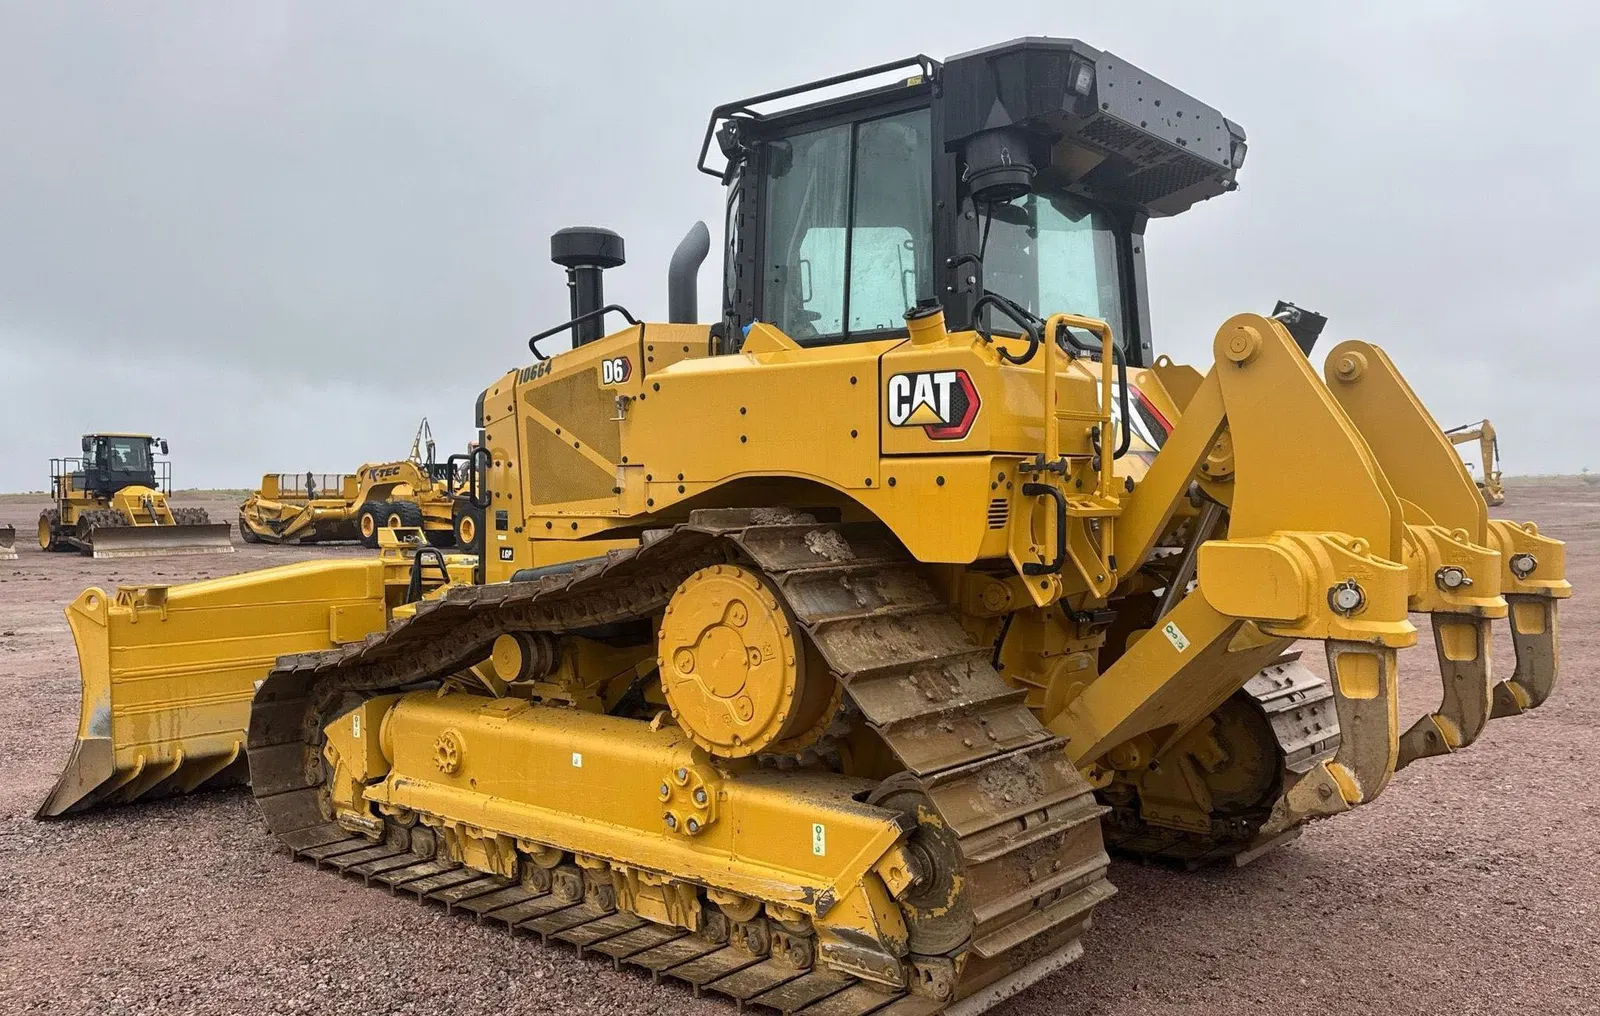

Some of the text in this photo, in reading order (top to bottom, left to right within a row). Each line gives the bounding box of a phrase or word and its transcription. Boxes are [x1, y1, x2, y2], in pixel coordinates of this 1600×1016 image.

[518, 358, 552, 385] 10664
[602, 358, 624, 385] D6
[888, 371, 957, 426] CAT
[369, 466, 401, 482] K-TEC
